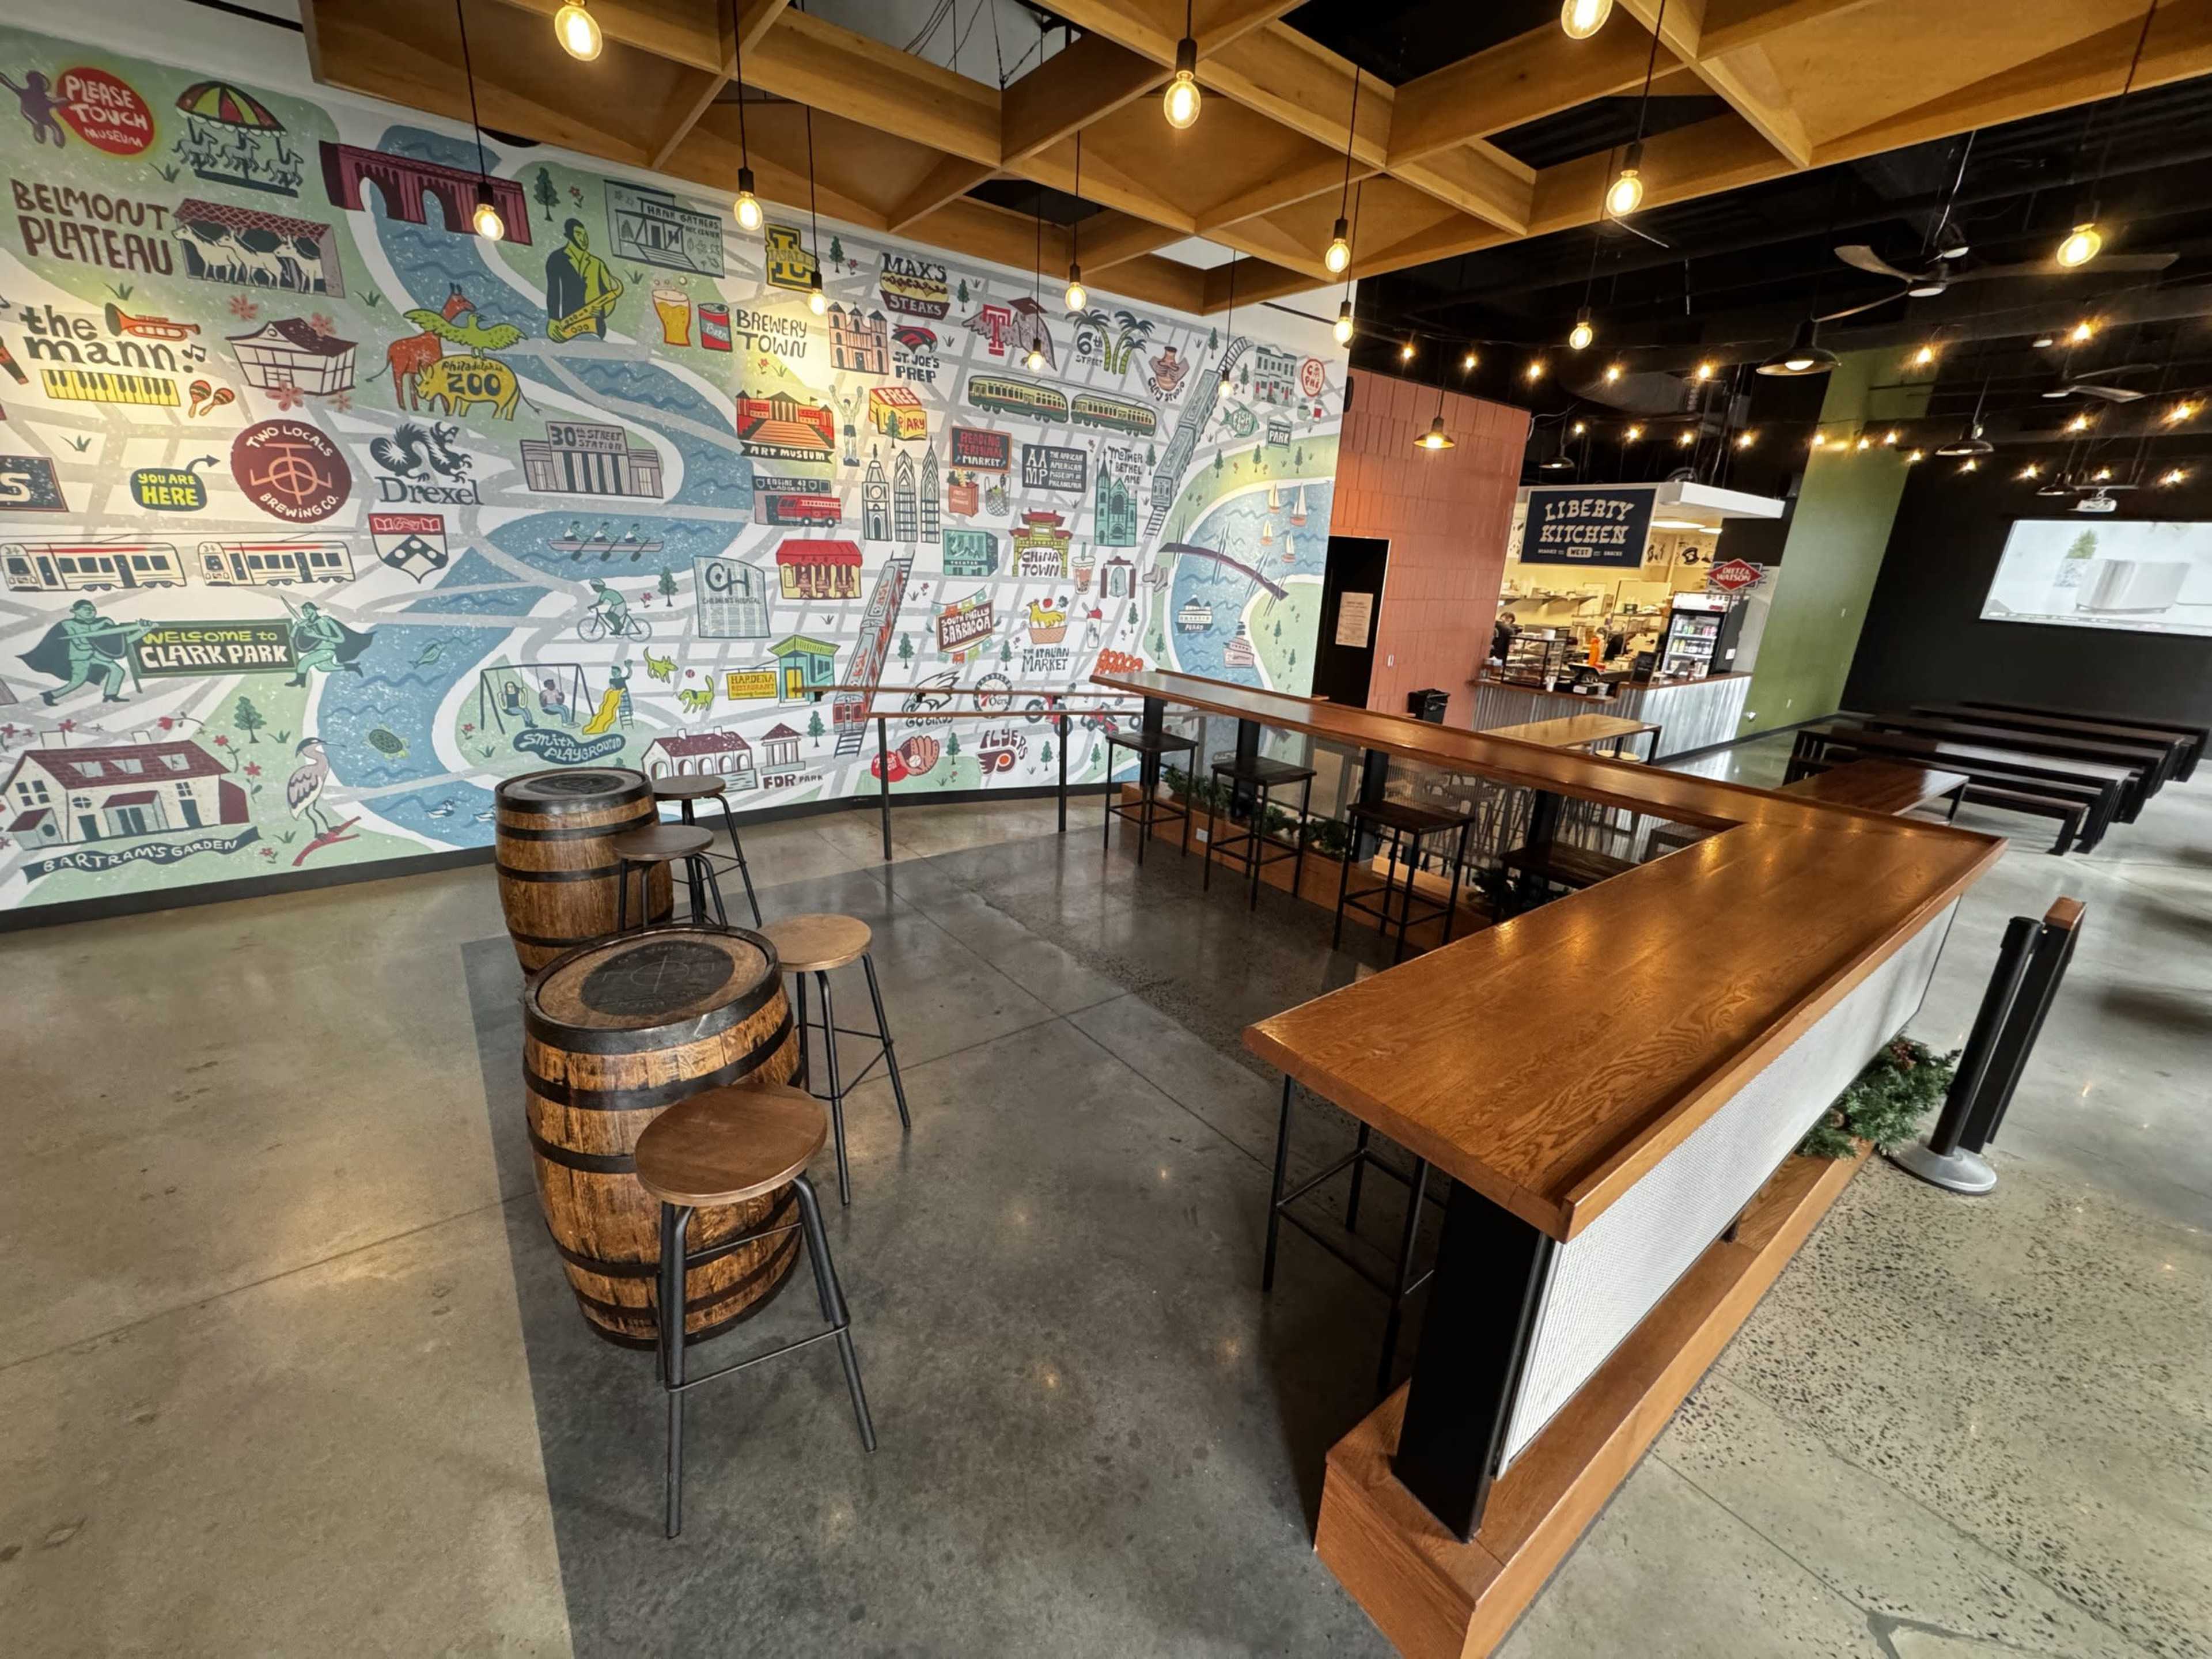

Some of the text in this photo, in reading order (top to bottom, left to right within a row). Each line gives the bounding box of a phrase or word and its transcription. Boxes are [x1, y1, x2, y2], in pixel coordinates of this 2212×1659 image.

[65, 75, 135, 108] PLEASE
[69, 104, 148, 131] TOUCH
[85, 127, 143, 147] MUSEUM
[10, 179, 169, 230] BELMONT
[647, 206, 718, 229] HANK GATHERS
[18, 215, 173, 275] PLATEAU
[882, 252, 947, 283] MAX'S
[889, 295, 942, 316] STEAKS
[19, 305, 97, 341] the
[737, 309, 807, 338] BREWERY
[737, 331, 806, 358] TOWN
[1077, 332, 1103, 355] 6th
[442, 361, 503, 373] Philadelphia
[893, 351, 940, 368] ST. JOE'S
[1075, 355, 1103, 367] STREET
[896, 365, 936, 383] PREP
[447, 373, 501, 396] ZOO
[1148, 377, 1185, 402] CLAY STUDIO
[877, 388, 918, 404] FREE
[246, 425, 334, 457] TWO LOCALS
[550, 426, 622, 446] 30th STREET
[1269, 430, 1290, 444] PARK
[750, 445, 825, 460] ART MUSEUM
[958, 443, 1003, 458] TERMINAL
[1108, 445, 1143, 463] MOTHER
[962, 455, 1001, 467] MARKET
[1115, 462, 1142, 475] BETHEL
[138, 474, 196, 485] YOU ARE
[1048, 480, 1082, 489] PHILADELPHIA
[1050, 471, 1074, 479] MUSEUM
[1124, 475, 1141, 485] AME
[141, 486, 200, 506] HERE
[374, 476, 484, 505] Drexel
[321, 496, 339, 510] CO.
[1545, 499, 1635, 521] LIBERTY
[1539, 525, 1629, 544] KITCHEN
[1021, 563, 1059, 577] TOWN
[1717, 573, 1751, 582] WATSON
[941, 616, 964, 626] SOUTH
[142, 631, 278, 645] WELCOME to
[942, 618, 991, 645] BARBACOA
[140, 645, 289, 668] CLARK PARK
[1022, 655, 1069, 673] MARKET
[731, 675, 774, 684] HARDENA
[544, 737, 622, 762] PLAYGROUND
[980, 729, 1028, 760] FLYERS
[763, 774, 823, 789] FDR PARK
[43, 839, 237, 872] BARTRAM'S GARDEN
